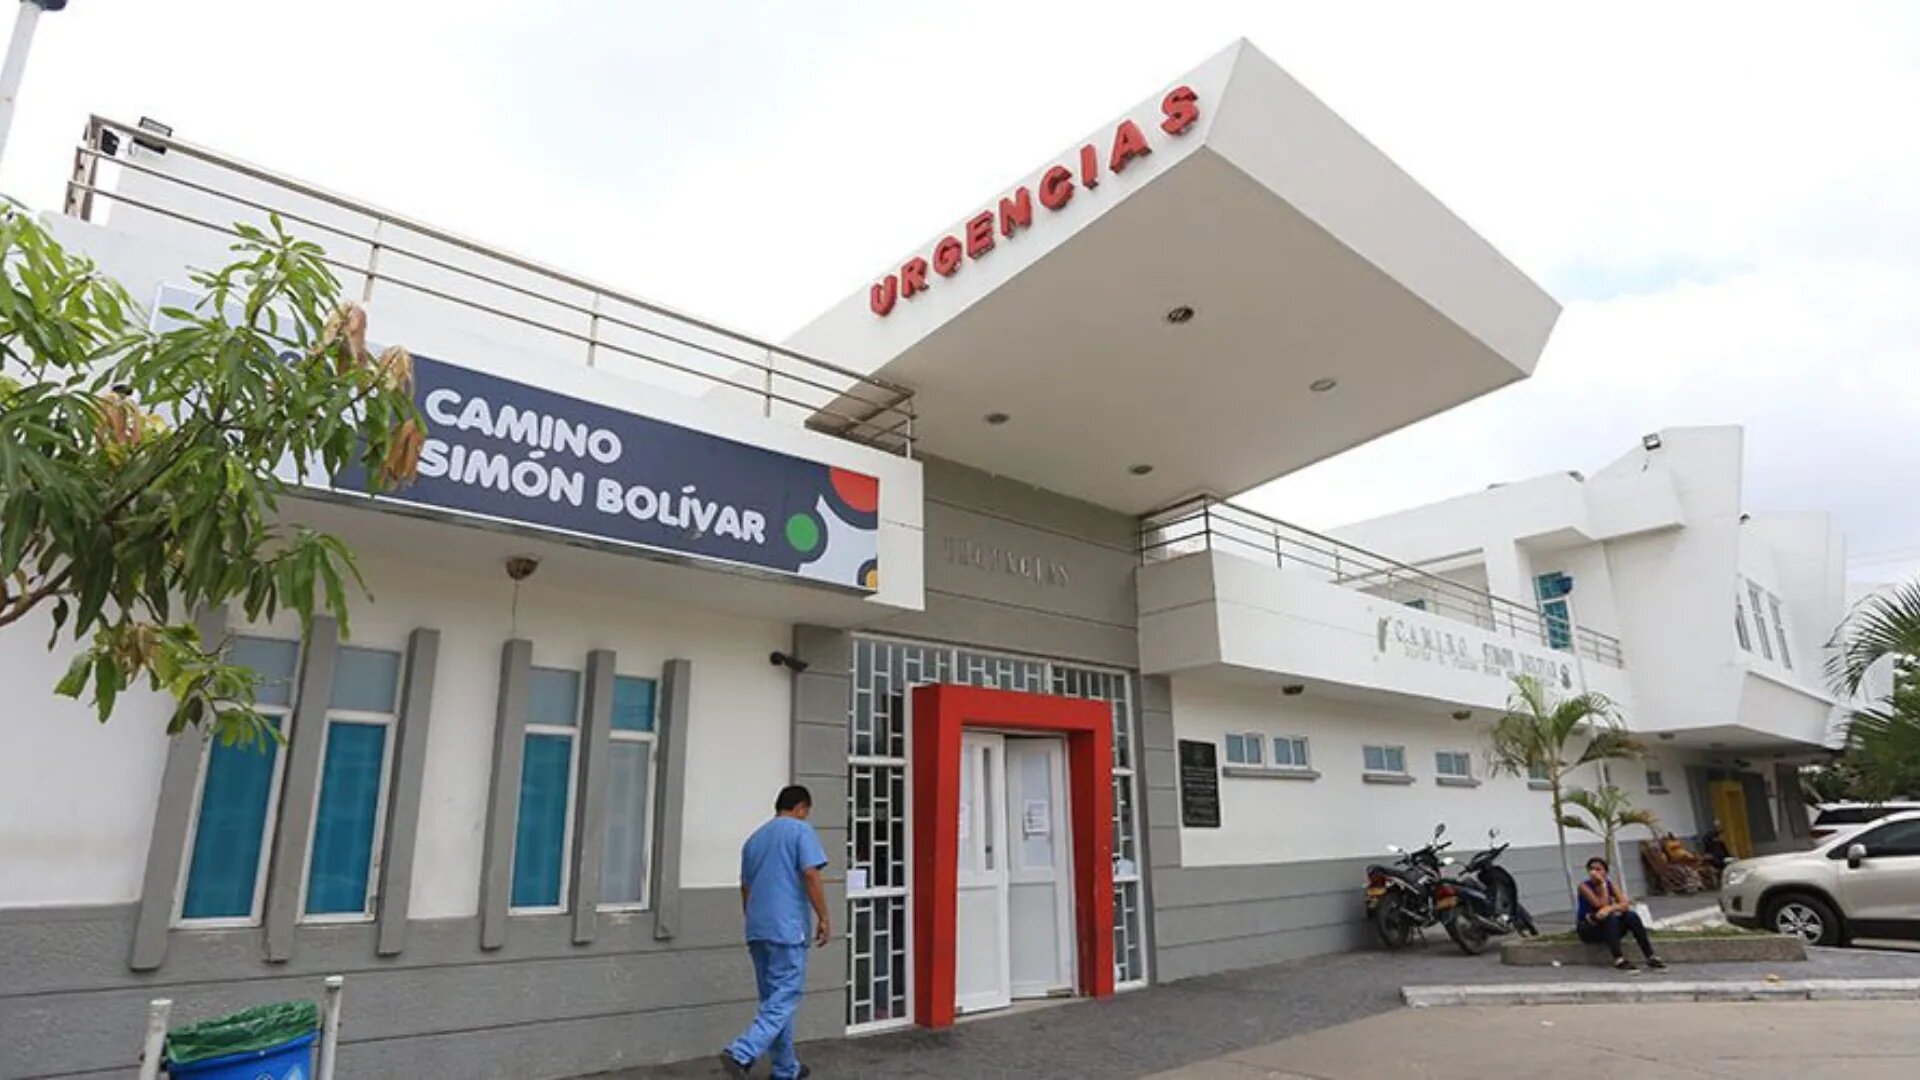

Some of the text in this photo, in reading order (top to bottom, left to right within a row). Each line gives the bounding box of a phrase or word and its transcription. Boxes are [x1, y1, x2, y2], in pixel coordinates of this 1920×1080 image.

[870, 86, 1200, 317] URGENCIAS
[425, 388, 622, 463] CAMINO
[416, 439, 766, 544] SIMÓN BOLÍVAR
